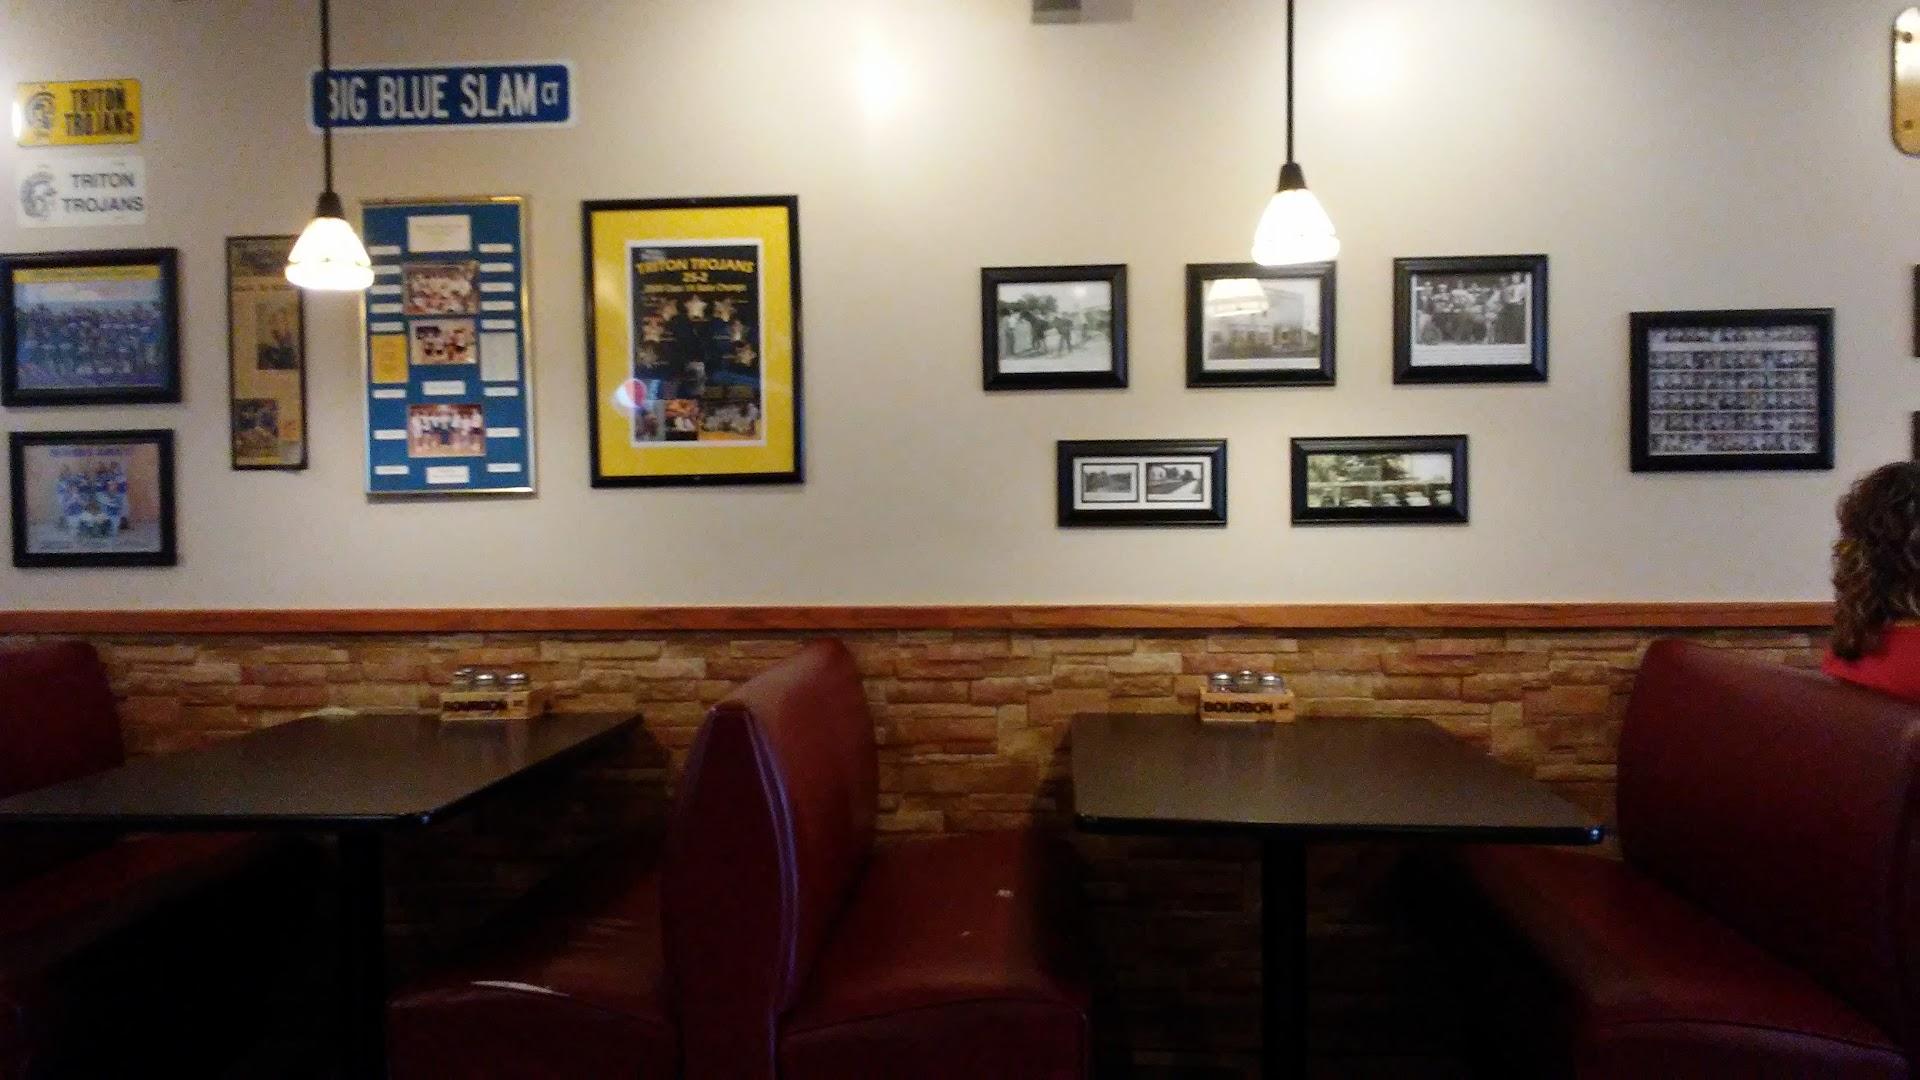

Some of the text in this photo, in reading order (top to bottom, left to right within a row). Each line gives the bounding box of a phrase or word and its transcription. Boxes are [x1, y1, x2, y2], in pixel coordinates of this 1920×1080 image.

[70, 87, 126, 111] TRITON
[378, 74, 450, 120] BLUE
[460, 71, 538, 118] SLAM
[540, 81, 560, 106] CT
[64, 111, 134, 136] TROJANS
[71, 172, 135, 189] TRITON
[61, 196, 144, 213] TROJANS
[637, 257, 754, 274] TRITON TROJANS
[1204, 701, 1274, 713] BOURBON
